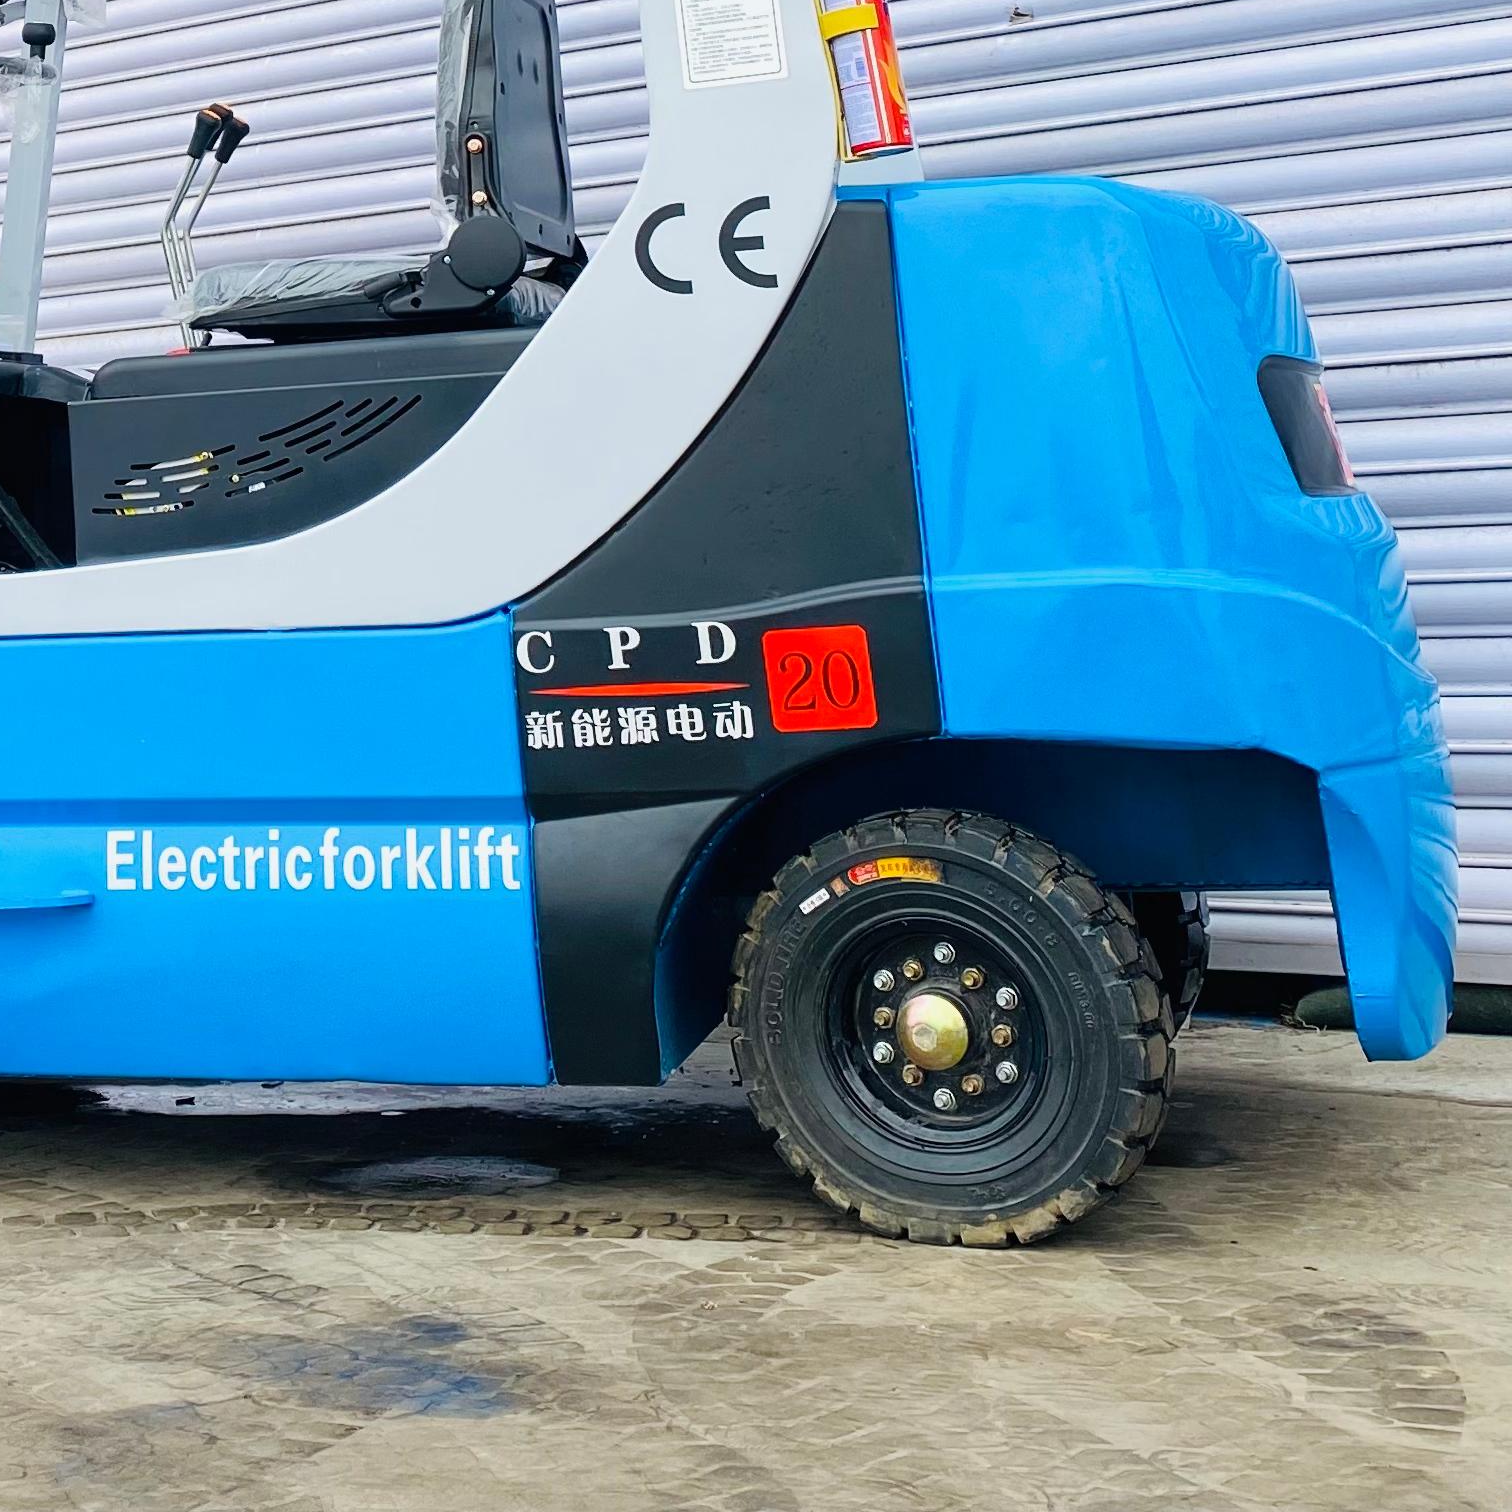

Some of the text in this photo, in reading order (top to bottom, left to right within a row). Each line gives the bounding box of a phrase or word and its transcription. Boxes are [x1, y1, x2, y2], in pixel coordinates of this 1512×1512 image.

[635, 196, 778, 294] CE
[778, 650, 861, 711] 20
[525, 701, 754, 750] 新能源电动
